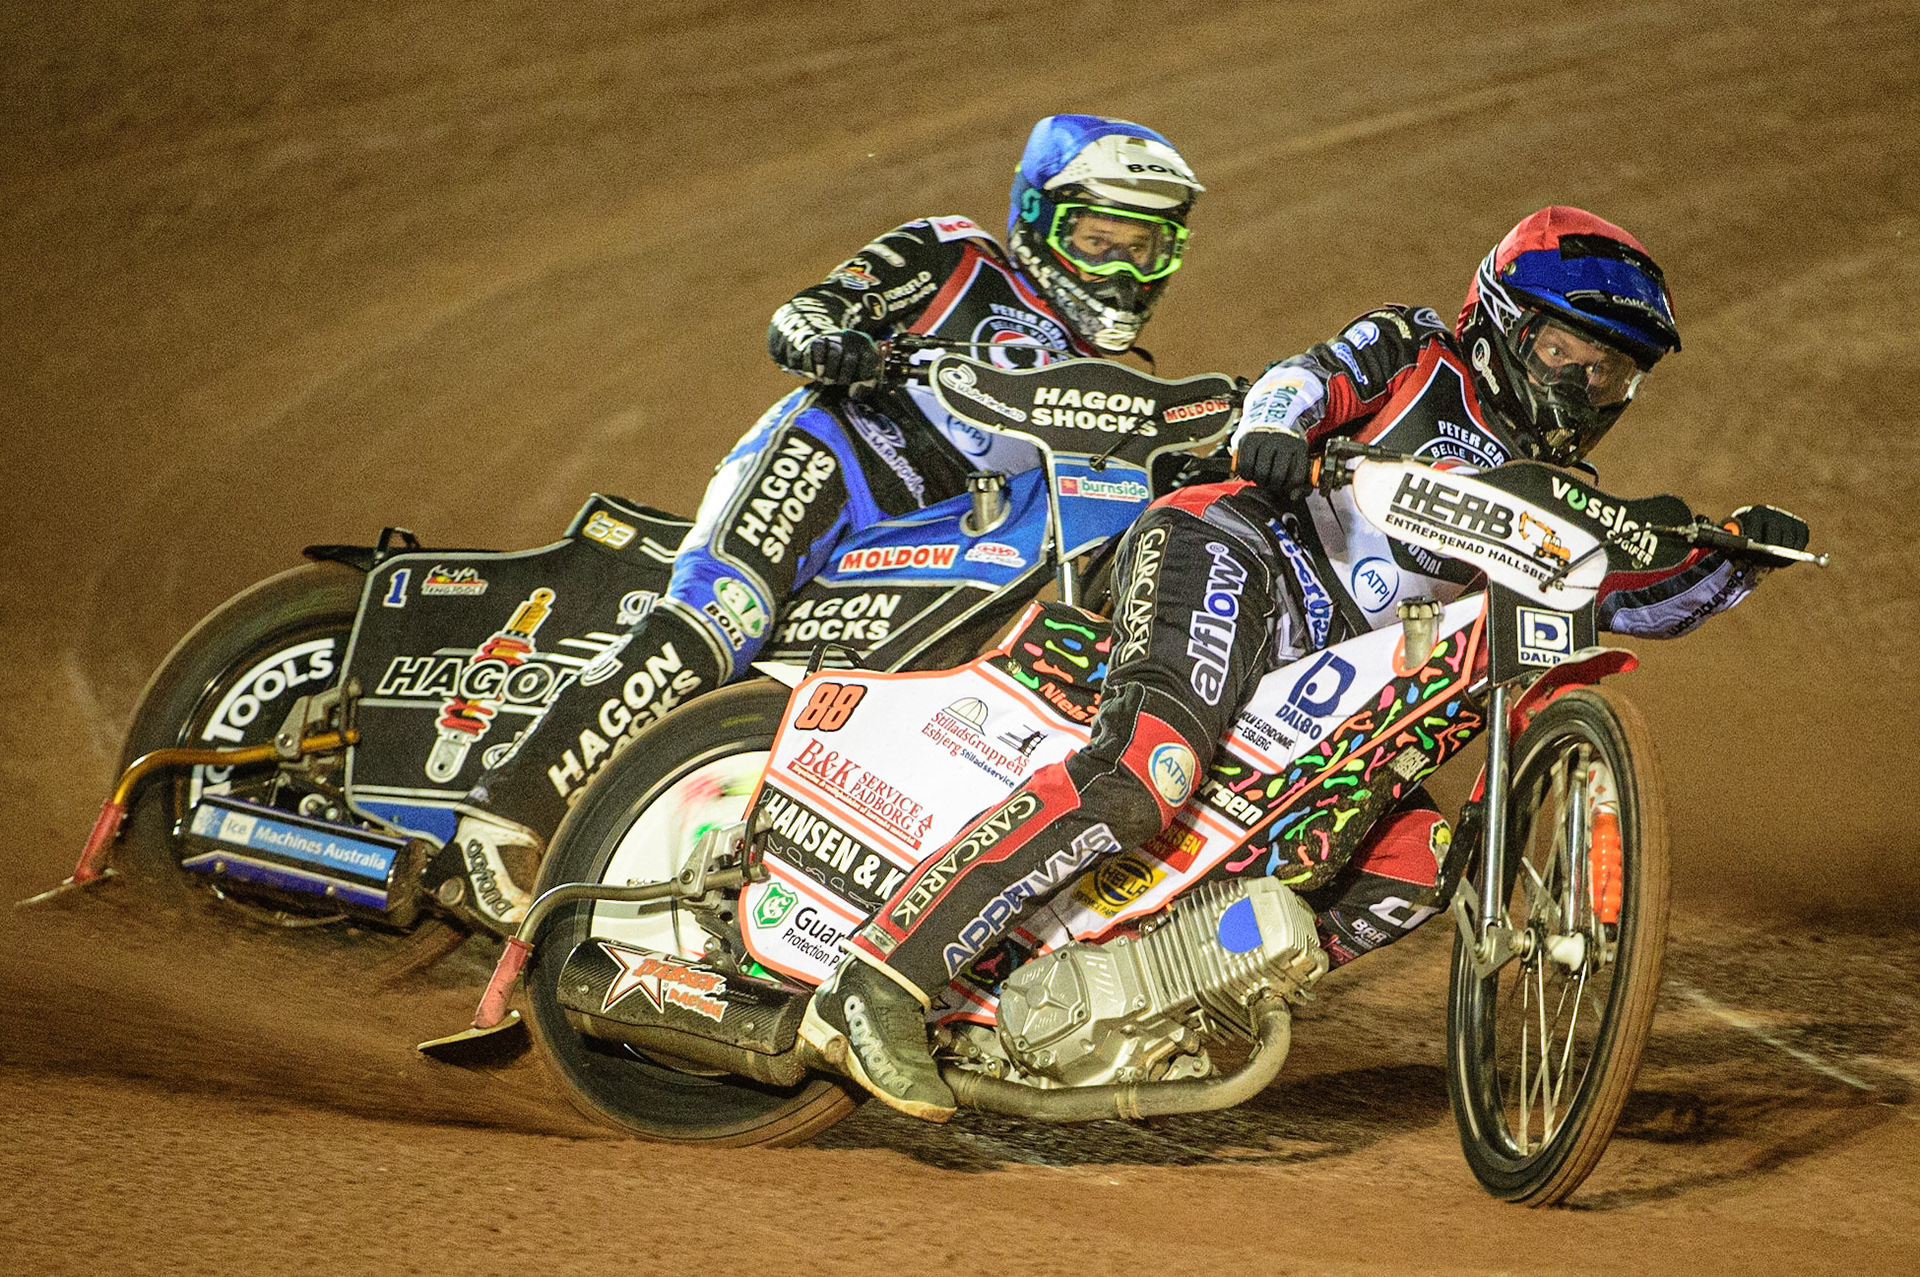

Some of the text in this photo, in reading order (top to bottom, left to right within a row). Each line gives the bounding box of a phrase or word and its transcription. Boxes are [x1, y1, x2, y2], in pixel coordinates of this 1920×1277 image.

[1031, 408, 1158, 437] SHOCKS
[1033, 387, 1156, 416] HAGON
[1165, 400, 1228, 422] MOLDOW
[1430, 444, 1466, 460] BELLE
[1438, 420, 1505, 468] PETER CR
[736, 437, 814, 547] HAGON
[762, 451, 836, 563] SHOCKS
[1081, 477, 1147, 498] burnside
[1393, 472, 1514, 541] HEAB
[1385, 513, 1485, 556] ENTREPRENAD
[841, 547, 957, 571] MOLDOW
[1401, 539, 1442, 576] ORIAL
[385, 570, 410, 607] 1
[787, 593, 902, 621] AGON
[1124, 526, 1167, 662] GARCAREK
[1360, 568, 1390, 603] ATPI
[706, 604, 743, 648] BOLL
[784, 618, 891, 643] HOCKS
[1189, 554, 1247, 705] alflow
[1520, 651, 1561, 665] DALB
[201, 649, 336, 743] TOOLS
[794, 682, 868, 732] 88
[548, 641, 684, 797] HAGON
[1241, 728, 1272, 752] ESBJERG
[1275, 703, 1323, 741] DALBO
[794, 738, 861, 789] B&K
[921, 722, 1015, 789] Esbjerg Stilladsservice
[931, 711, 1024, 777] StilladsGruppen
[858, 771, 923, 819] SERVICE
[1159, 757, 1190, 793] ATPI
[850, 782, 914, 831] PADBORG
[1202, 782, 1264, 826] rsen
[224, 819, 387, 871] Ice Machines Australia
[764, 794, 906, 901] HANSEN & K
[892, 794, 1038, 926] GARCAREK
[782, 927, 830, 964] Protection
[794, 906, 848, 955] Guar
